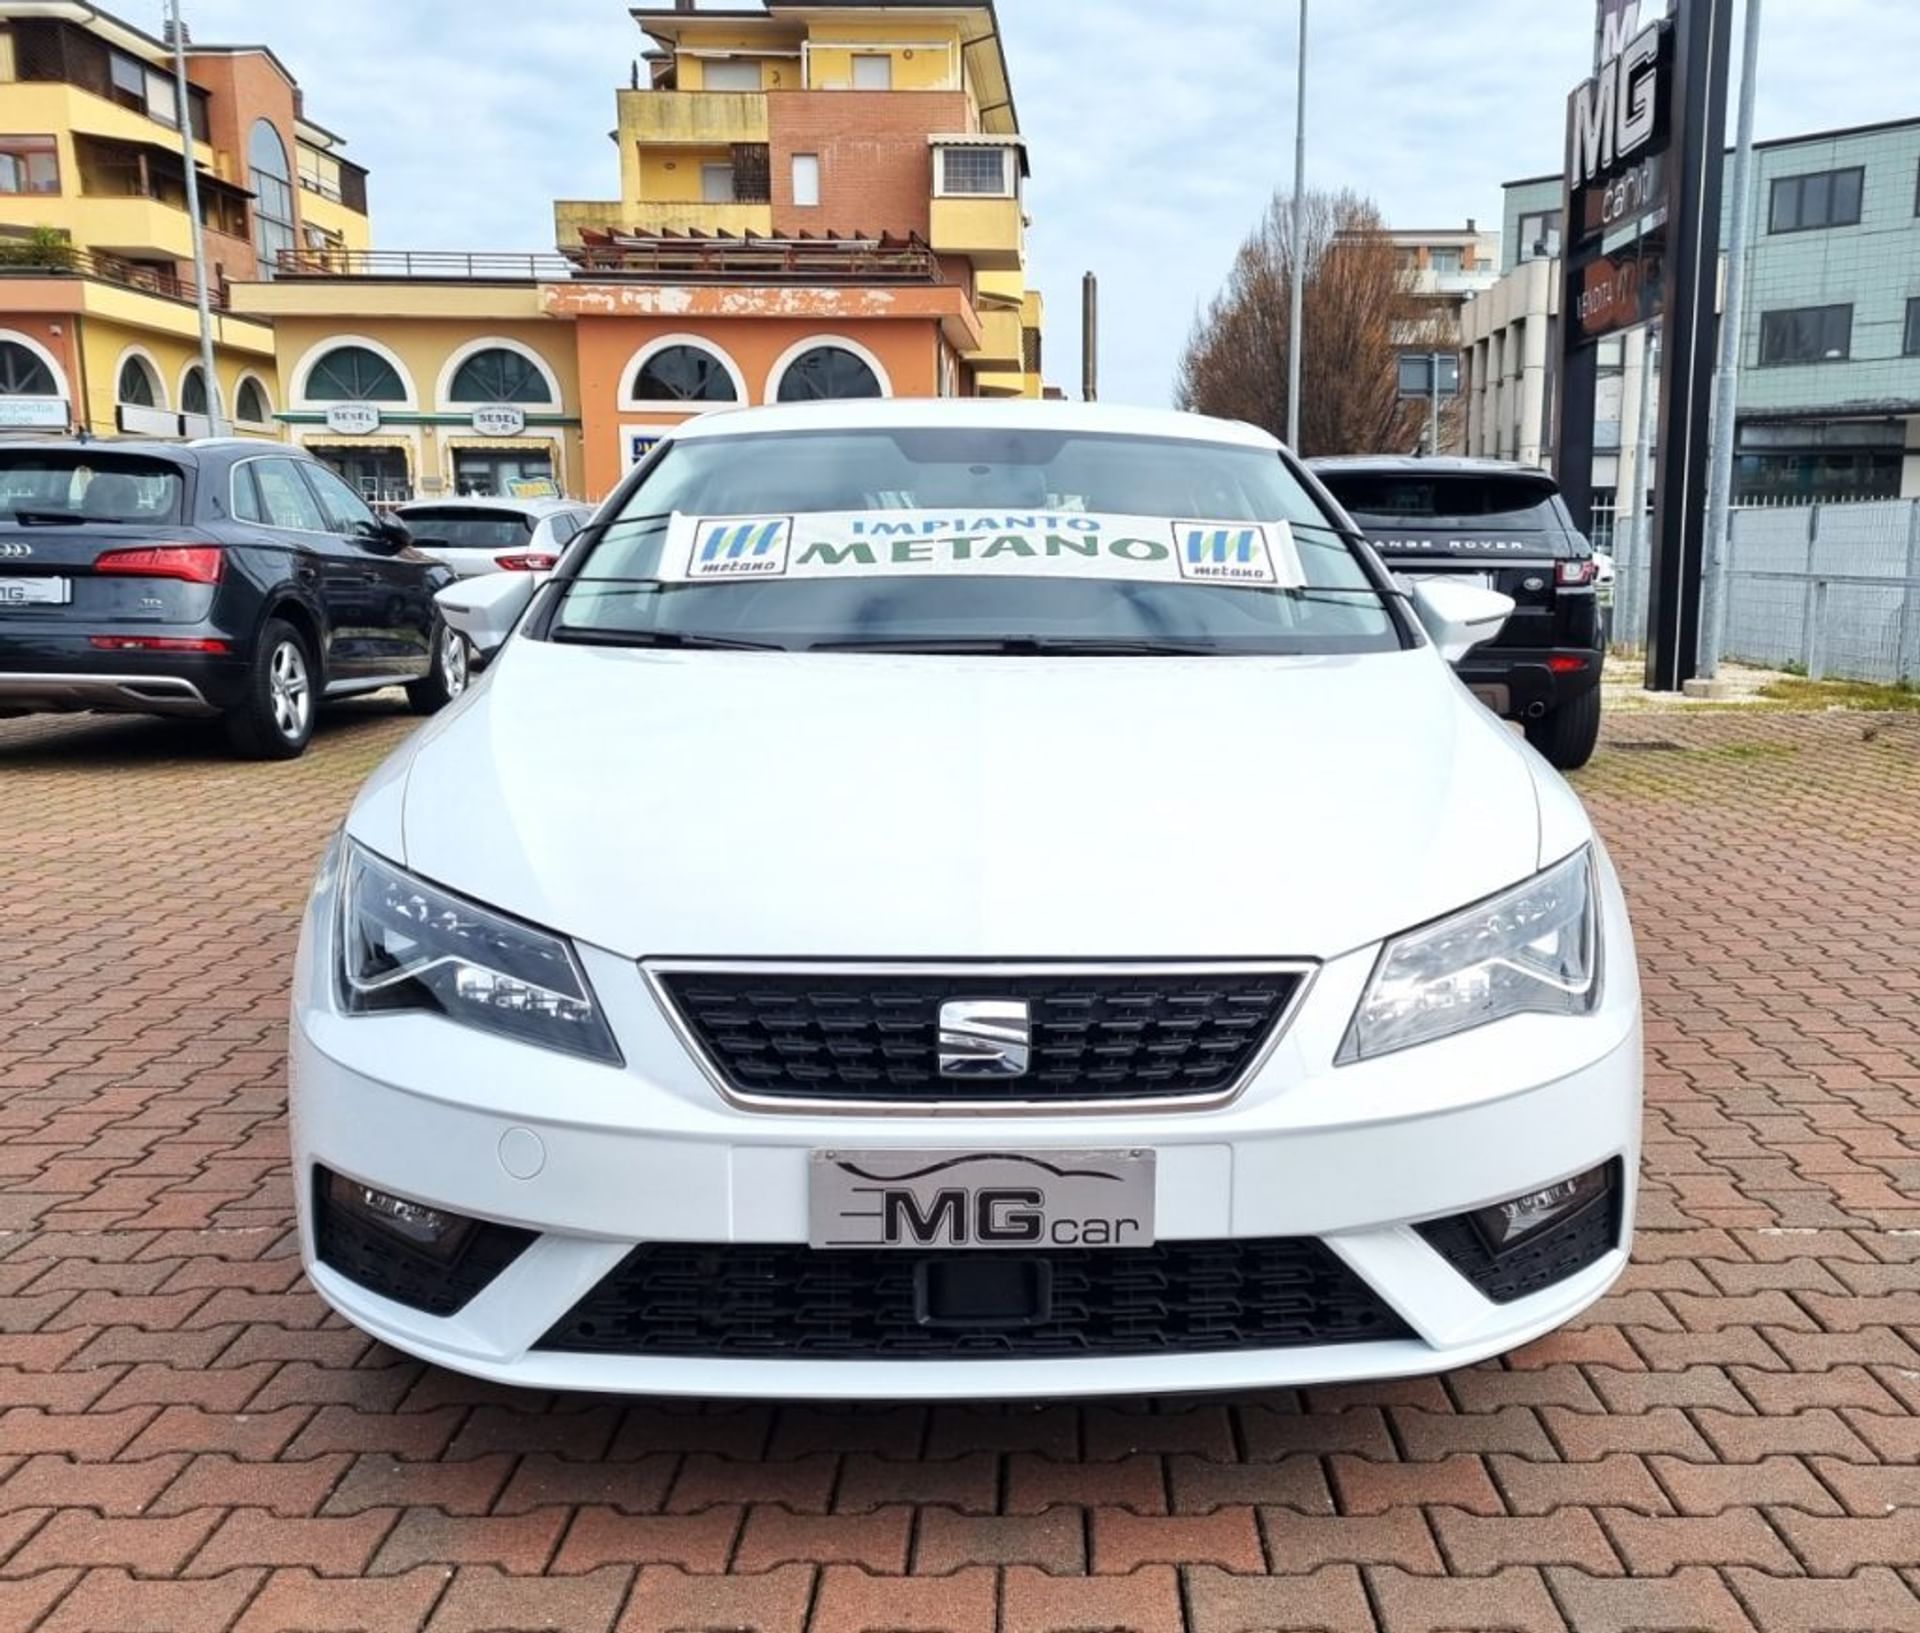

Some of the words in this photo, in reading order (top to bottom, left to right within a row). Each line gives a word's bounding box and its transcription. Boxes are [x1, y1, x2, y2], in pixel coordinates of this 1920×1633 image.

[1571, 22, 1658, 190] MG
[333, 411, 373, 422] SESEL
[479, 414, 519, 425] SESEL
[852, 516, 1101, 534] IMPIANTO
[796, 534, 1170, 564] METANO
[1372, 540, 1432, 548] ANGE
[1449, 541, 1523, 549] ROVER
[701, 561, 776, 573] metano
[1194, 565, 1265, 578] metano
[883, 1187, 1045, 1246] MG
[1051, 1217, 1140, 1244] car
